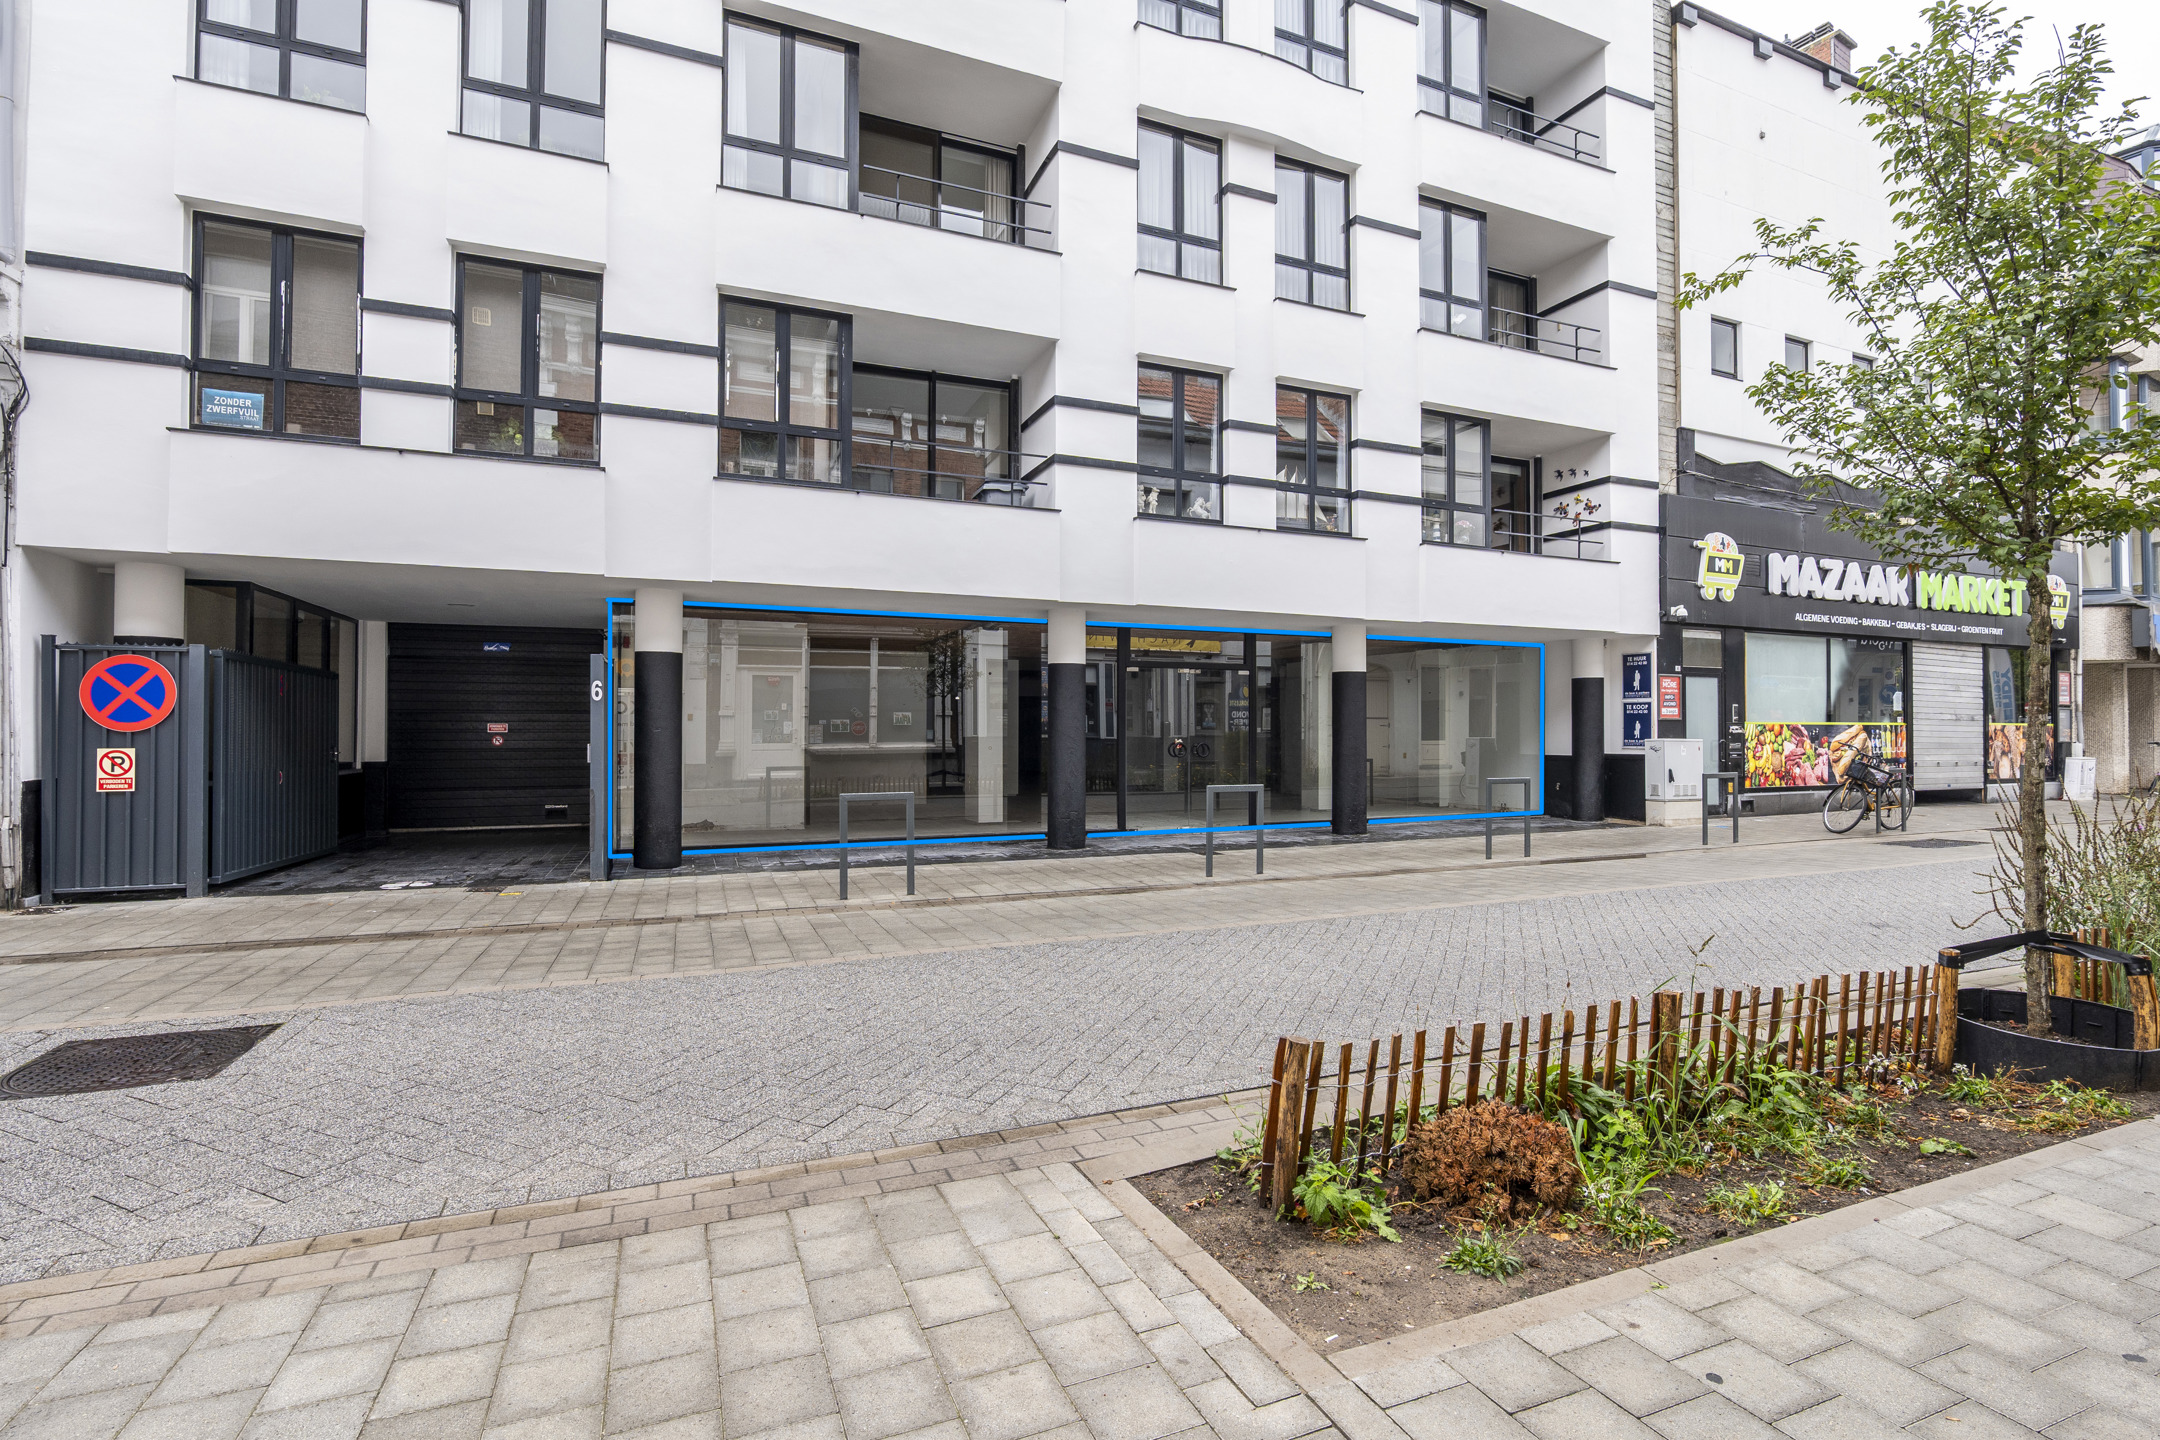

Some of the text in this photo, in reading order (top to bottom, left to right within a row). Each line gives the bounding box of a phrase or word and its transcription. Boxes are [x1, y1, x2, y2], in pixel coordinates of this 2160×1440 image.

[206, 405, 259, 417] ZWERFVUIL
[214, 396, 252, 407] ZONDER
[1715, 557, 1733, 574] MM
[1916, 570, 2027, 616] MARKET
[1795, 612, 1830, 623] ALGEMENE
[1830, 615, 1858, 625] VOEDING
[1862, 617, 1891, 627] BAKKERIJ
[1895, 621, 1926, 631] GEBAKJES
[1931, 623, 1957, 632] SLAGERIJ
[1961, 625, 1988, 634] GROENTEN
[1989, 627, 2004, 635] FRUIT
[591, 680, 603, 701] 6
